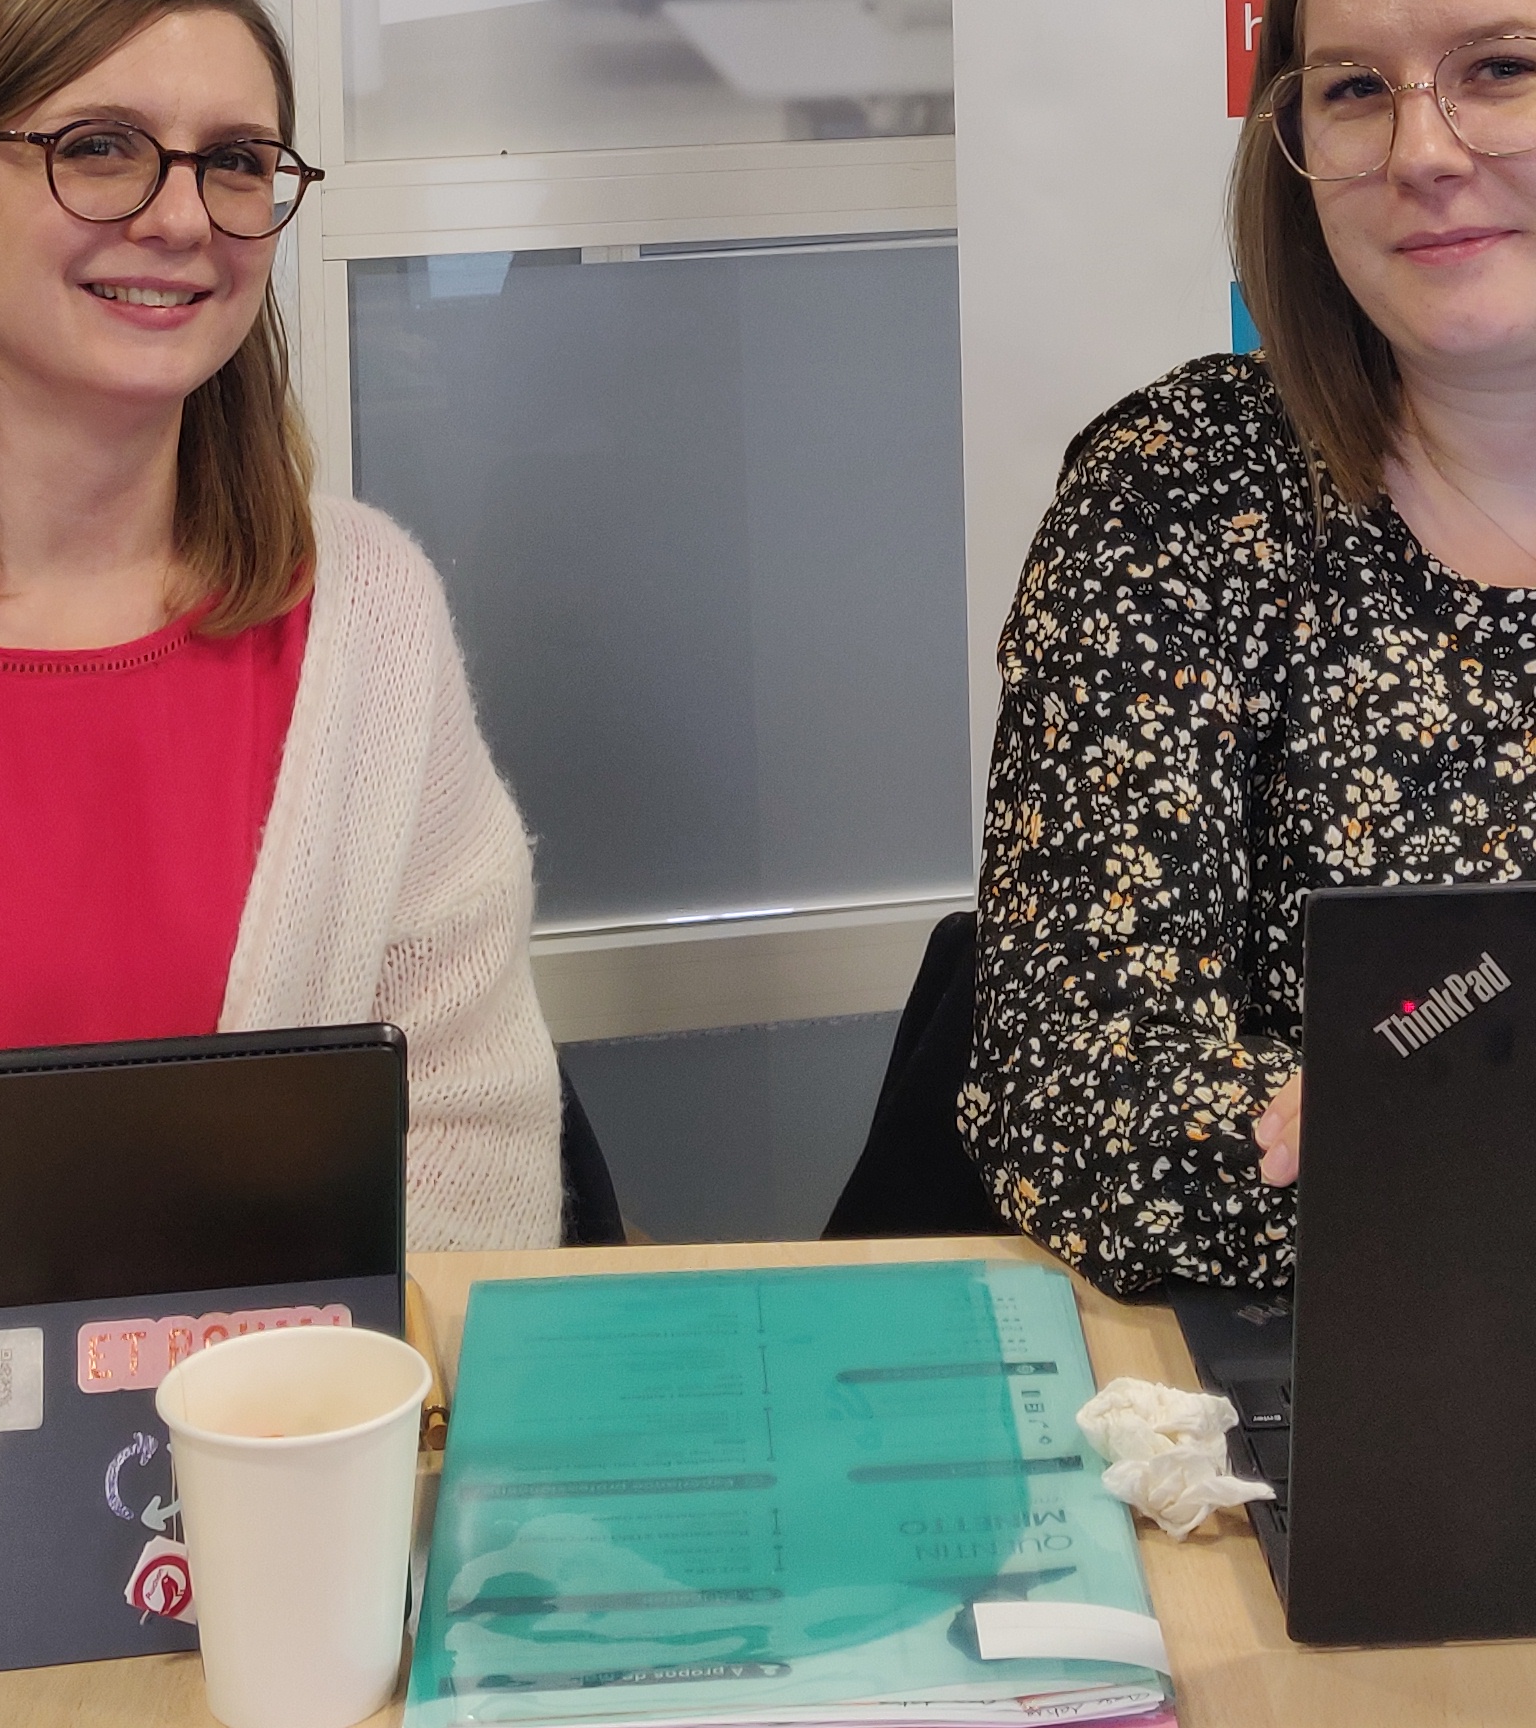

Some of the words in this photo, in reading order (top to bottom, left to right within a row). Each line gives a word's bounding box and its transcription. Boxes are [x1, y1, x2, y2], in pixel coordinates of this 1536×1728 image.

[1372, 950, 1513, 1059] ThinkPad
[87, 1330, 148, 1382] ET
[652, 1666, 725, 1680] propos
